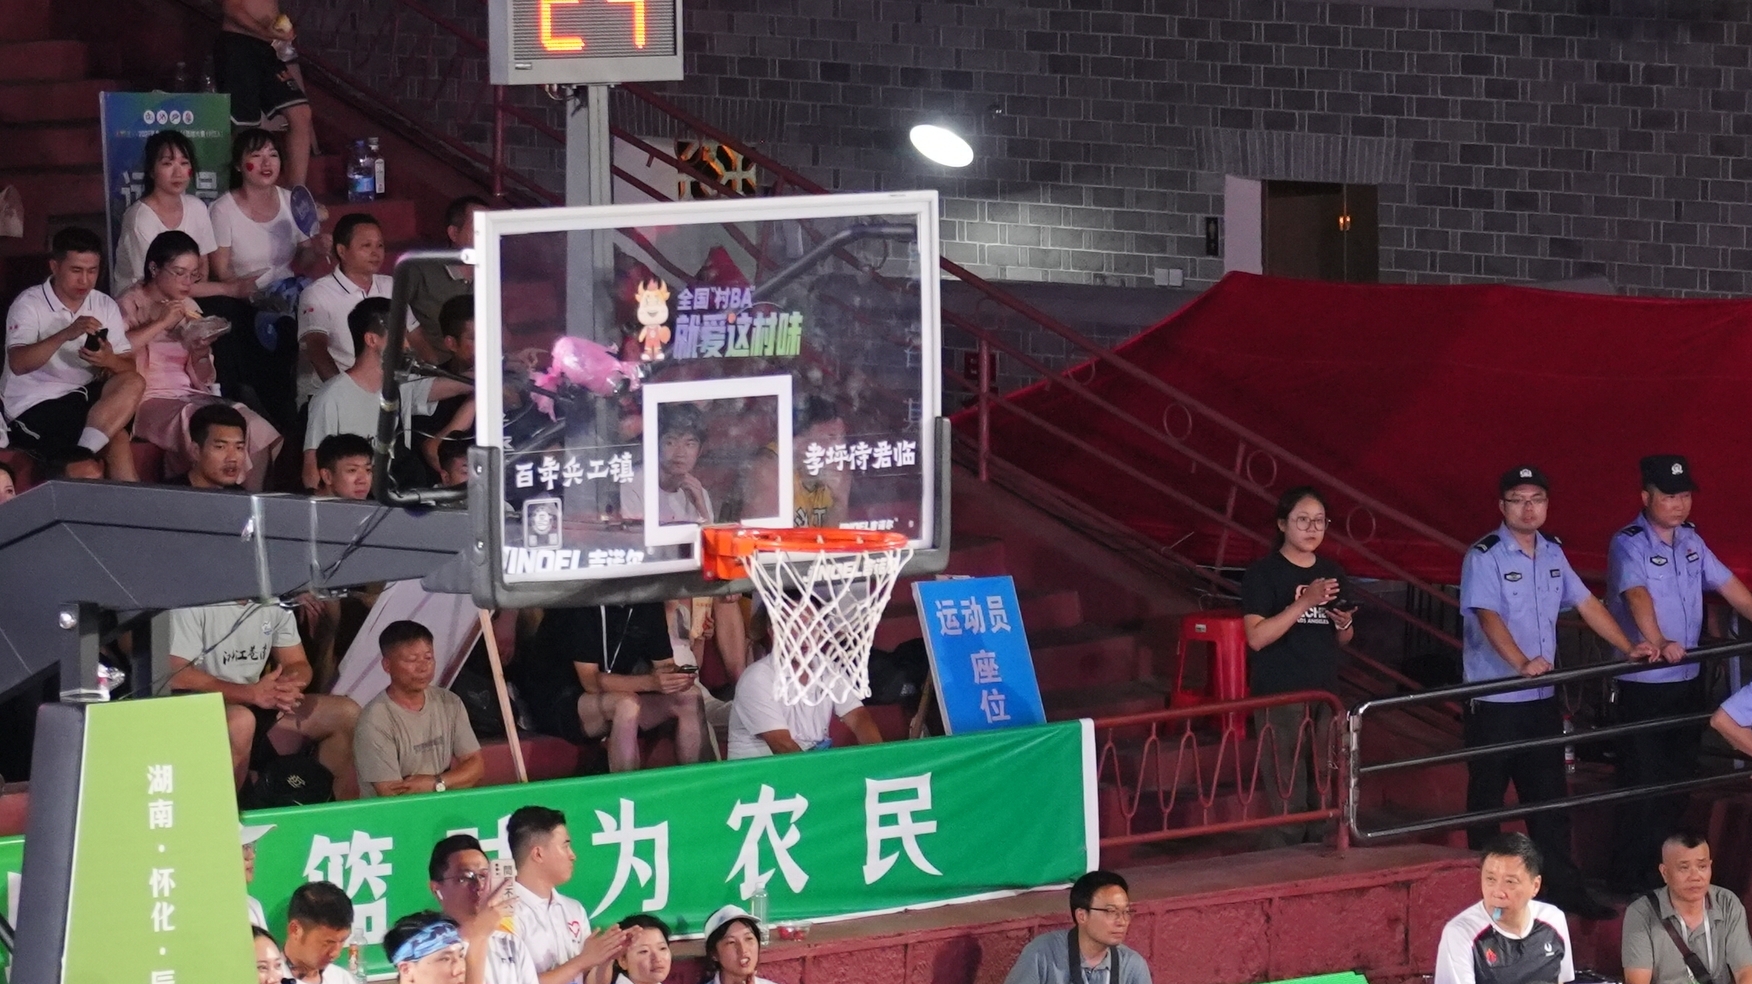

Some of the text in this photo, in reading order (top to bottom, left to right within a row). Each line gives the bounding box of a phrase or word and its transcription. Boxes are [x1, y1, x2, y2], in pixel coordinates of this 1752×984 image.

[672, 310, 804, 359] 就爱这村味
[515, 452, 635, 490] 百年兵工镇
[803, 440, 917, 475] 孝坪待君临
[935, 596, 1011, 636] 运动员
[970, 649, 1011, 723] 座位
[303, 771, 943, 944] 篮为农民
